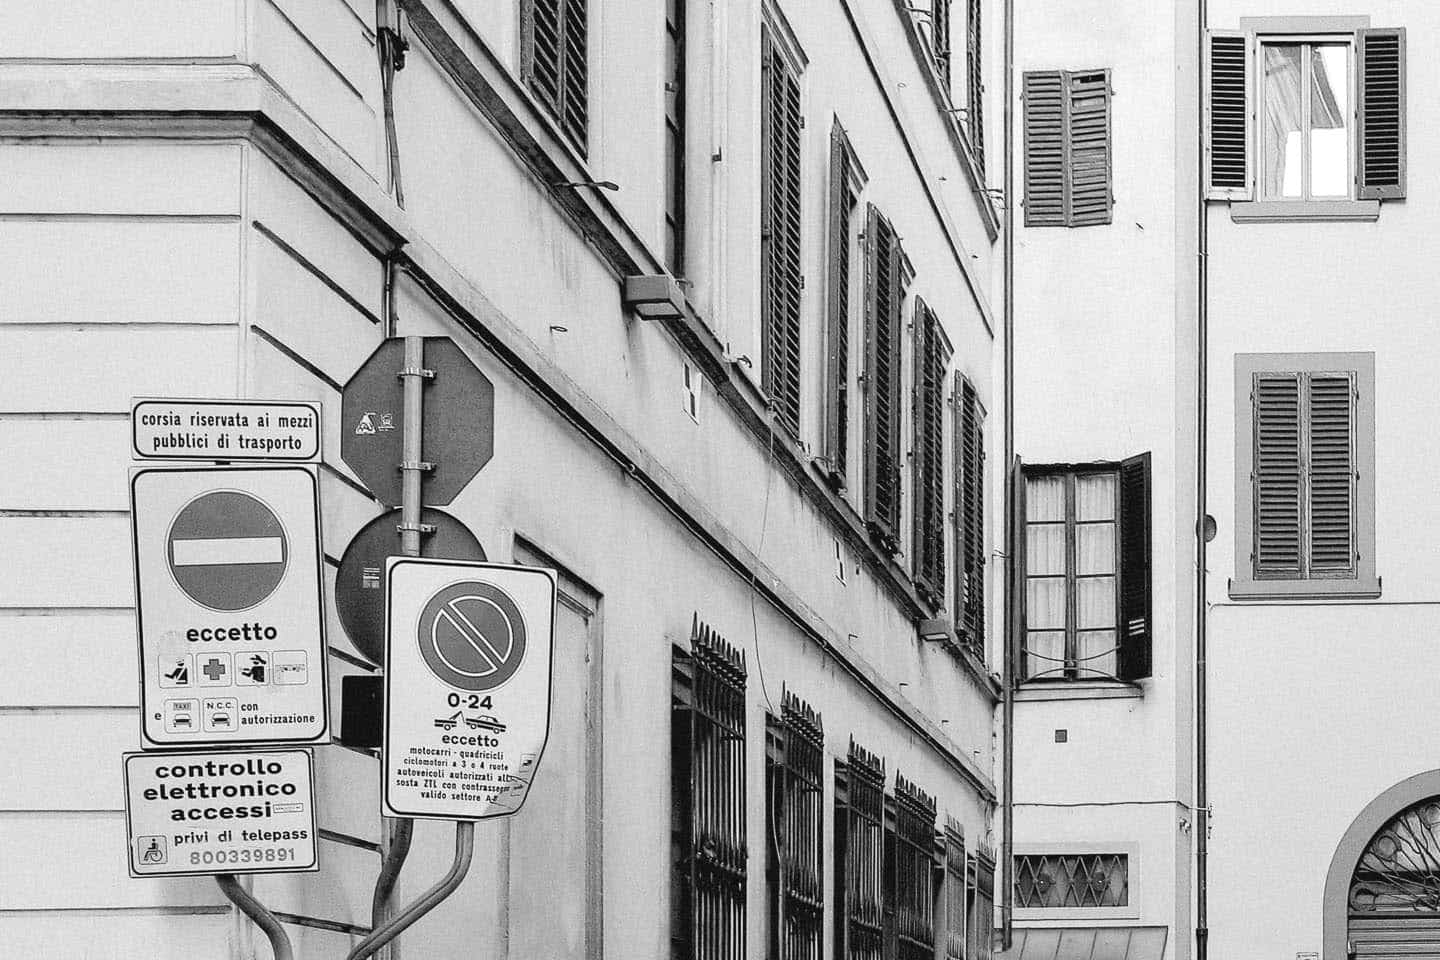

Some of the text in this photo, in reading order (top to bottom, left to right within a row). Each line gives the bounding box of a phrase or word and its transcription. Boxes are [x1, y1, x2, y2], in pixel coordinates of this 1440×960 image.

[142, 411, 312, 428] corsia riservata ai mezzi
[153, 433, 302, 452] pubblici di trasporto
[186, 623, 277, 641] eccetto
[241, 702, 258, 712] con
[447, 692, 493, 710] 0-24
[154, 712, 162, 721] e
[241, 713, 315, 725] autorizzazione
[442, 734, 499, 748] eccetto
[409, 747, 451, 756] motocarri
[459, 749, 504, 760] quadricicli
[155, 759, 282, 778] controllo
[403, 757, 448, 767] ciclomotori
[461, 760, 466, 768] 3
[480, 761, 485, 769] 4
[397, 768, 445, 778] autoveicoli
[449, 771, 493, 781] autorizzati
[143, 780, 297, 800] elettronico
[396, 779, 418, 787] sosta
[424, 779, 437, 788] ZTL
[420, 790, 447, 800] valido
[451, 792, 481, 802] settore
[171, 802, 271, 821] accessi
[174, 829, 308, 846] privi di telepass
[190, 848, 295, 864] 800339891
